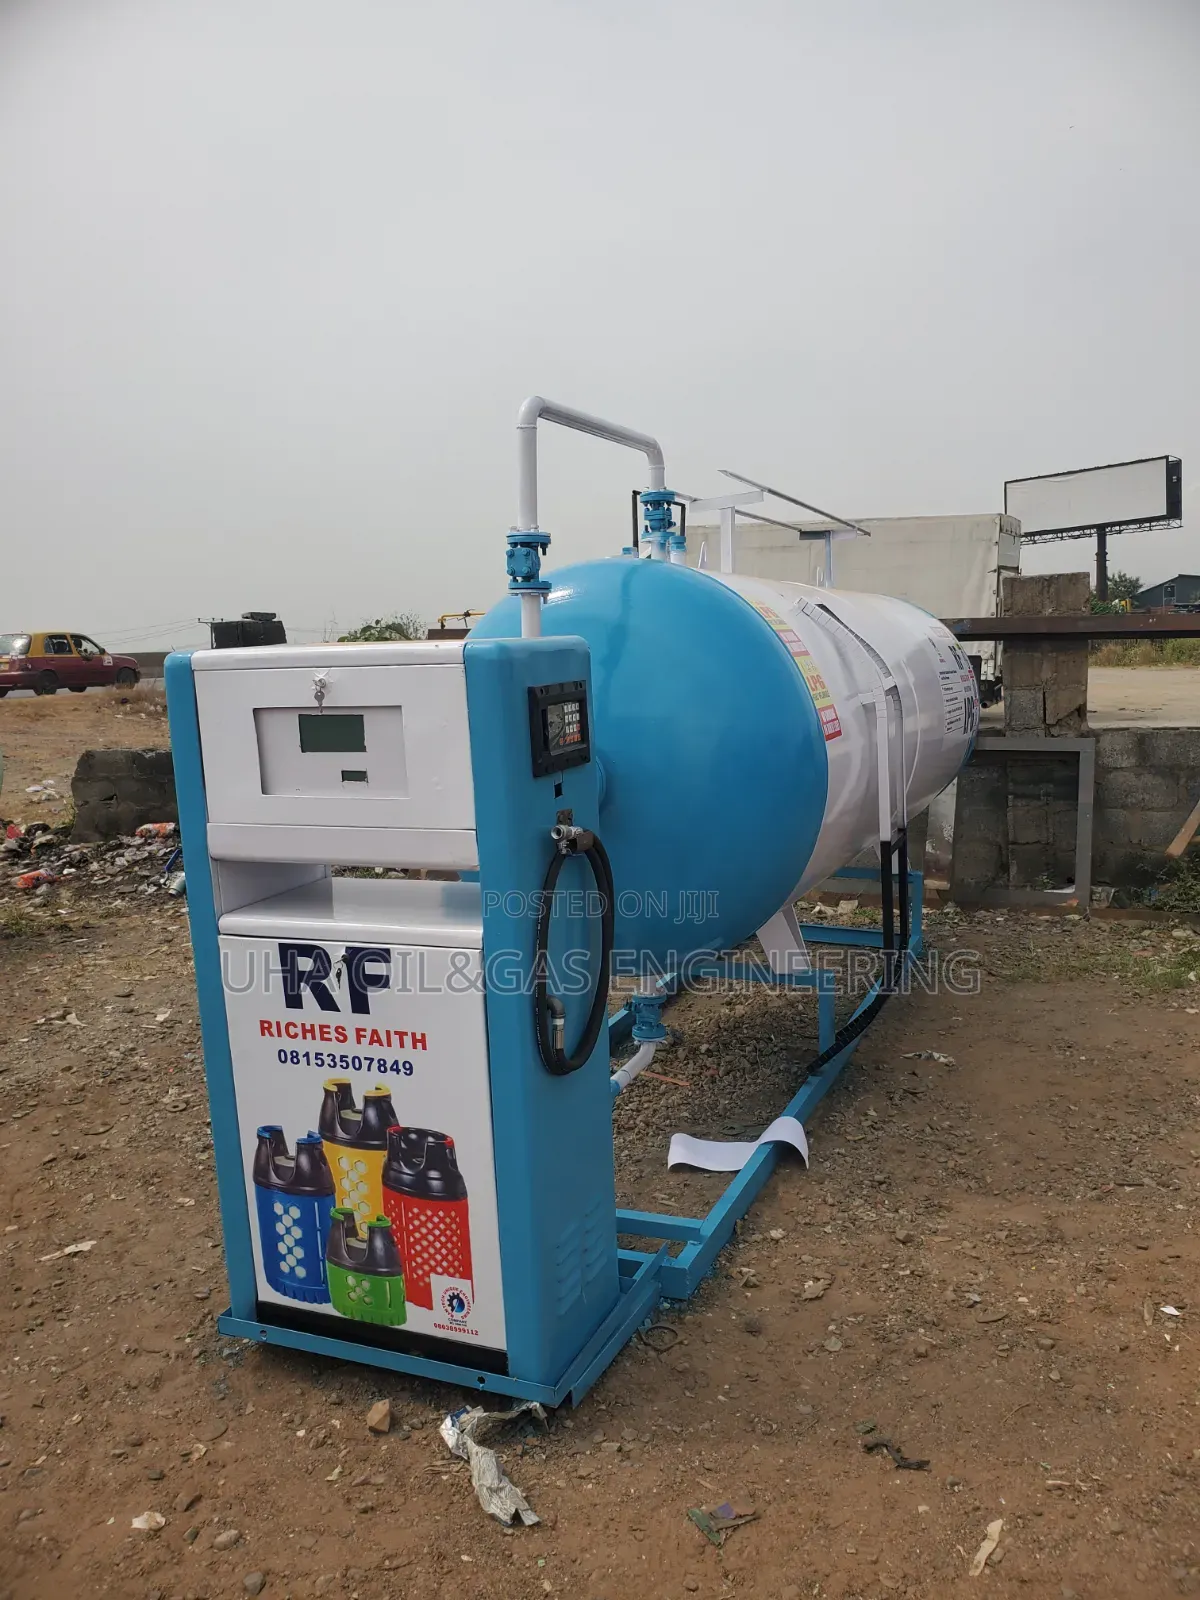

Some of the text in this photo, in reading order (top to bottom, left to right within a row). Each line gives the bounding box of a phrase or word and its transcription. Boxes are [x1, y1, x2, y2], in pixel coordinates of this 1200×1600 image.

[806, 674, 826, 692] LPG
[278, 943, 391, 1015] RF
[259, 1019, 428, 1051] RICHES FAITH
[277, 1048, 415, 1077] 08153507849
